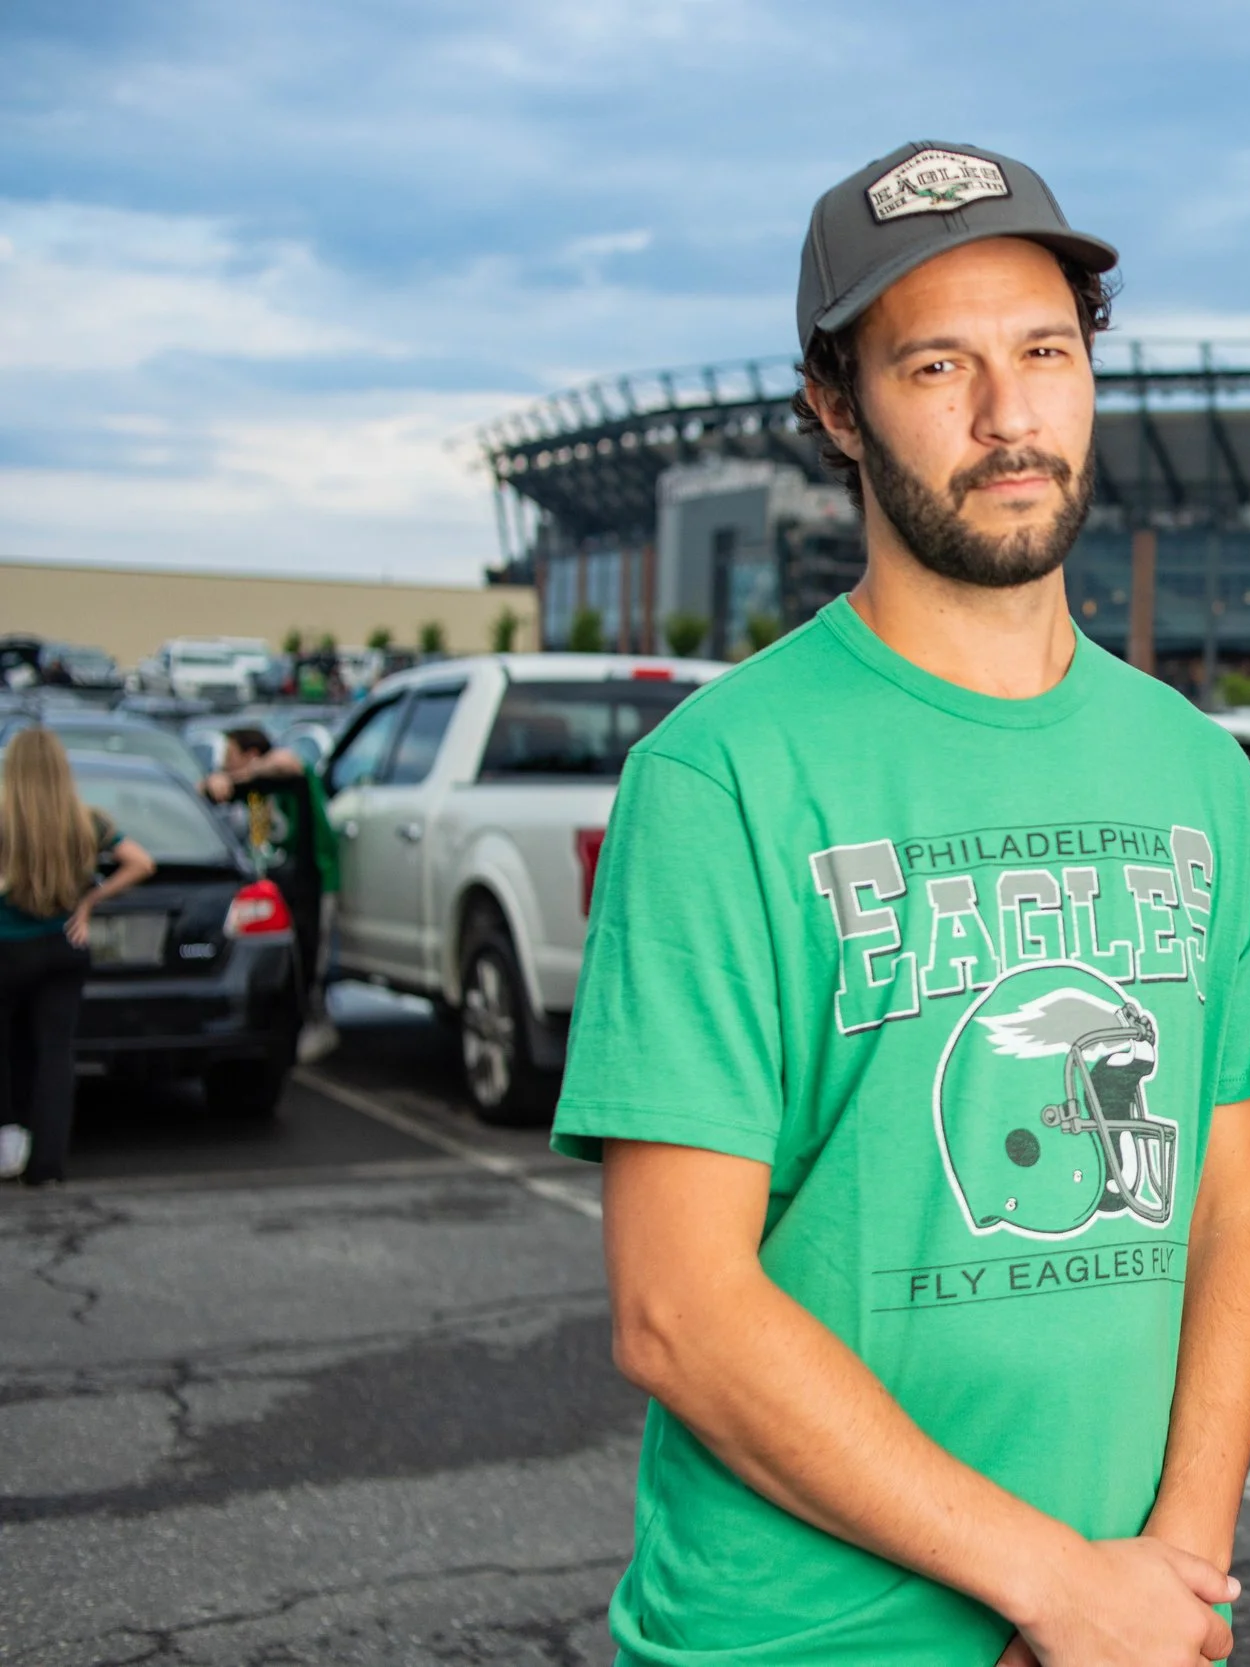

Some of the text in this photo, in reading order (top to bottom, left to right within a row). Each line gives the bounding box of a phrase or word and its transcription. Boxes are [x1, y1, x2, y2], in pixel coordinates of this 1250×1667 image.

[873, 165, 1002, 206] EAGLES
[904, 827, 1171, 870] PHILADELPHIA
[808, 825, 1213, 1037] EAGLES
[910, 1247, 1175, 1302] FLY EAGLES FLY
